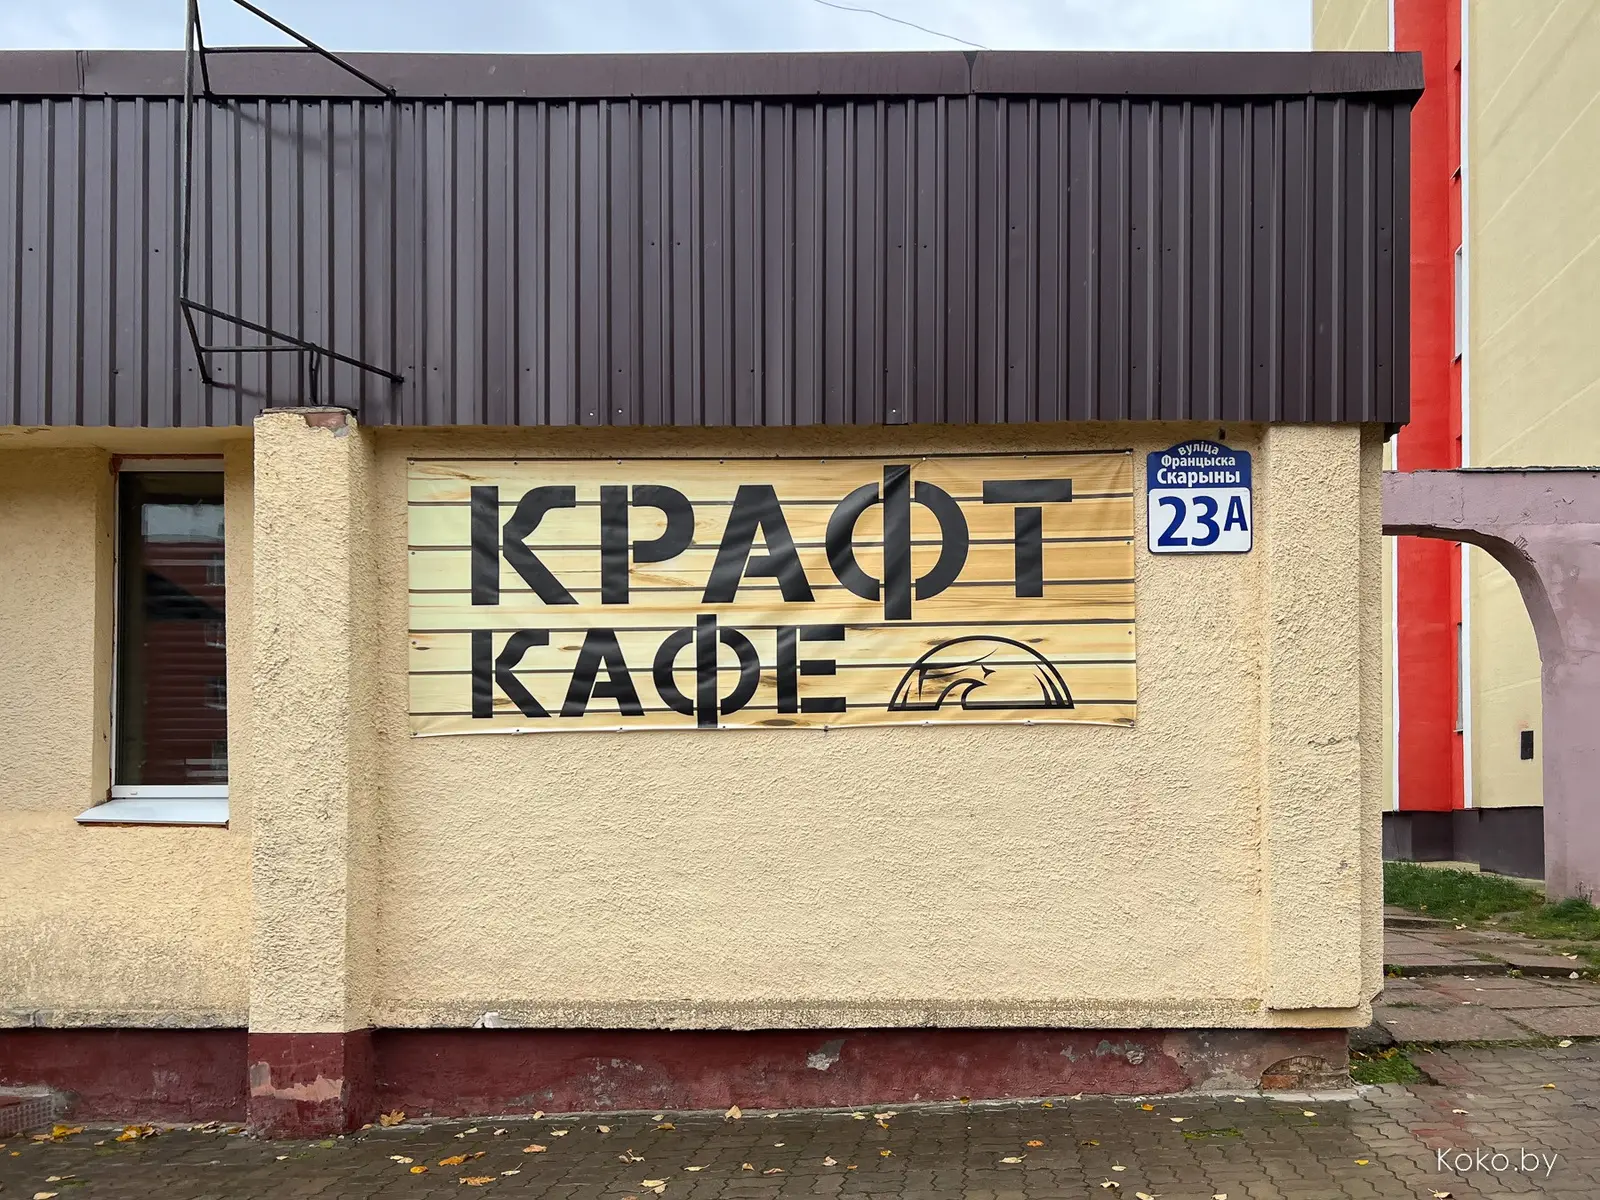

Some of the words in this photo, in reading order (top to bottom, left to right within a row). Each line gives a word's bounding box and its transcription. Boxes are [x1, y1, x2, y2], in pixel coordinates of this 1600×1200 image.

[1178, 441, 1219, 456] вуліца
[1161, 454, 1236, 469] Францыска
[1156, 468, 1240, 488] Скарыны
[470, 464, 1072, 620] КРАФТ
[470, 613, 846, 729] КАФЕ
